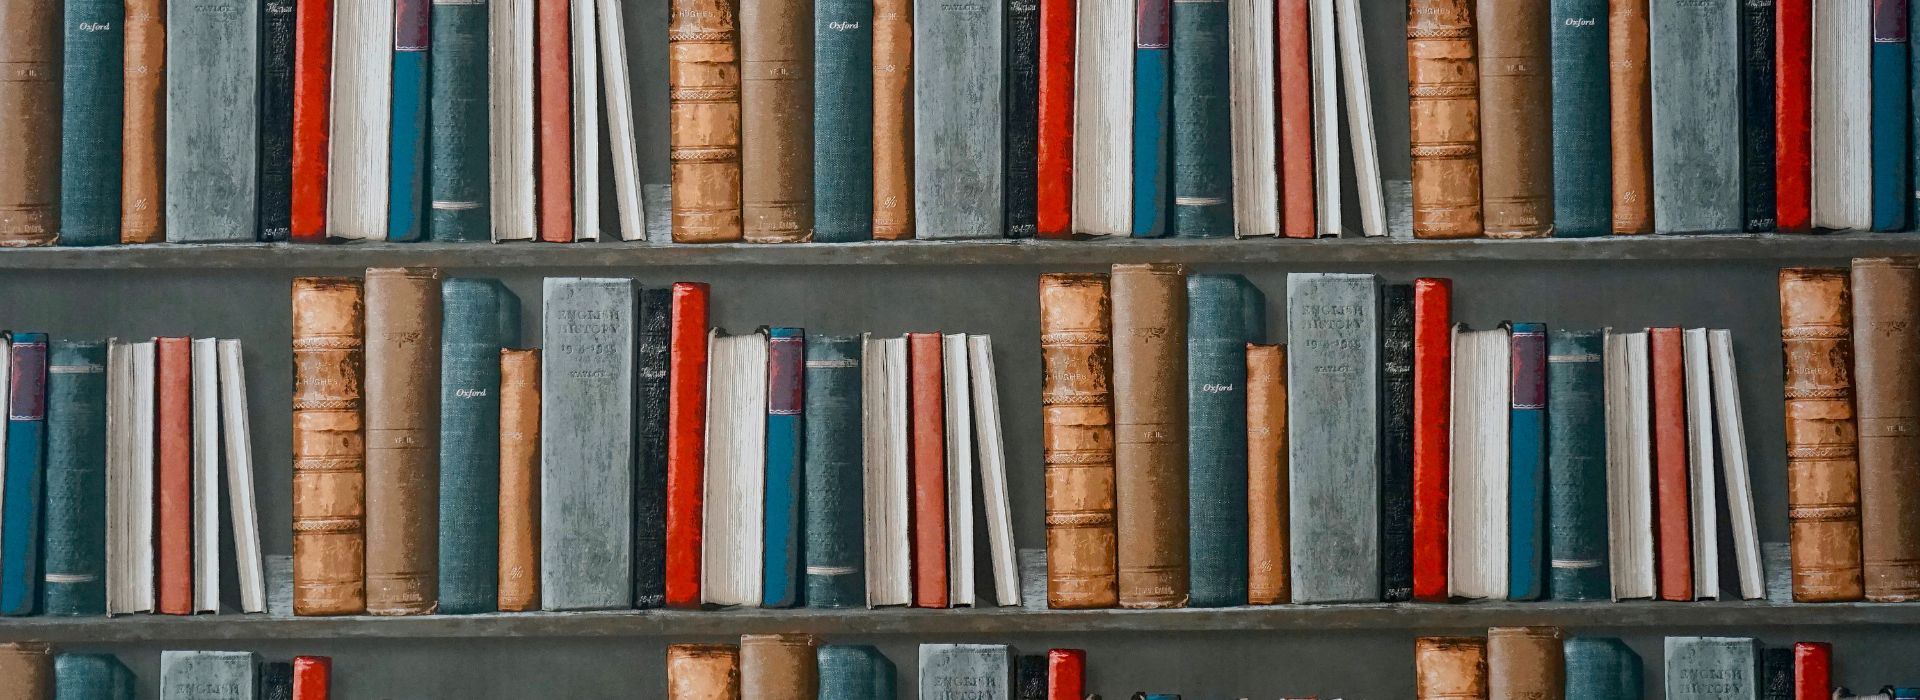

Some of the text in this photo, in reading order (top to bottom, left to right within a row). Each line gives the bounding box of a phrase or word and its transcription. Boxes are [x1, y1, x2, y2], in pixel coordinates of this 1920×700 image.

[79, 22, 110, 32] Oxford
[829, 21, 859, 32] Oxford
[1565, 18, 1595, 28] Oxford
[558, 310, 620, 320] ENGLISH
[1302, 305, 1363, 316] ENGLISH
[455, 388, 486, 399] Oxford
[1203, 383, 1233, 394] Oxford
